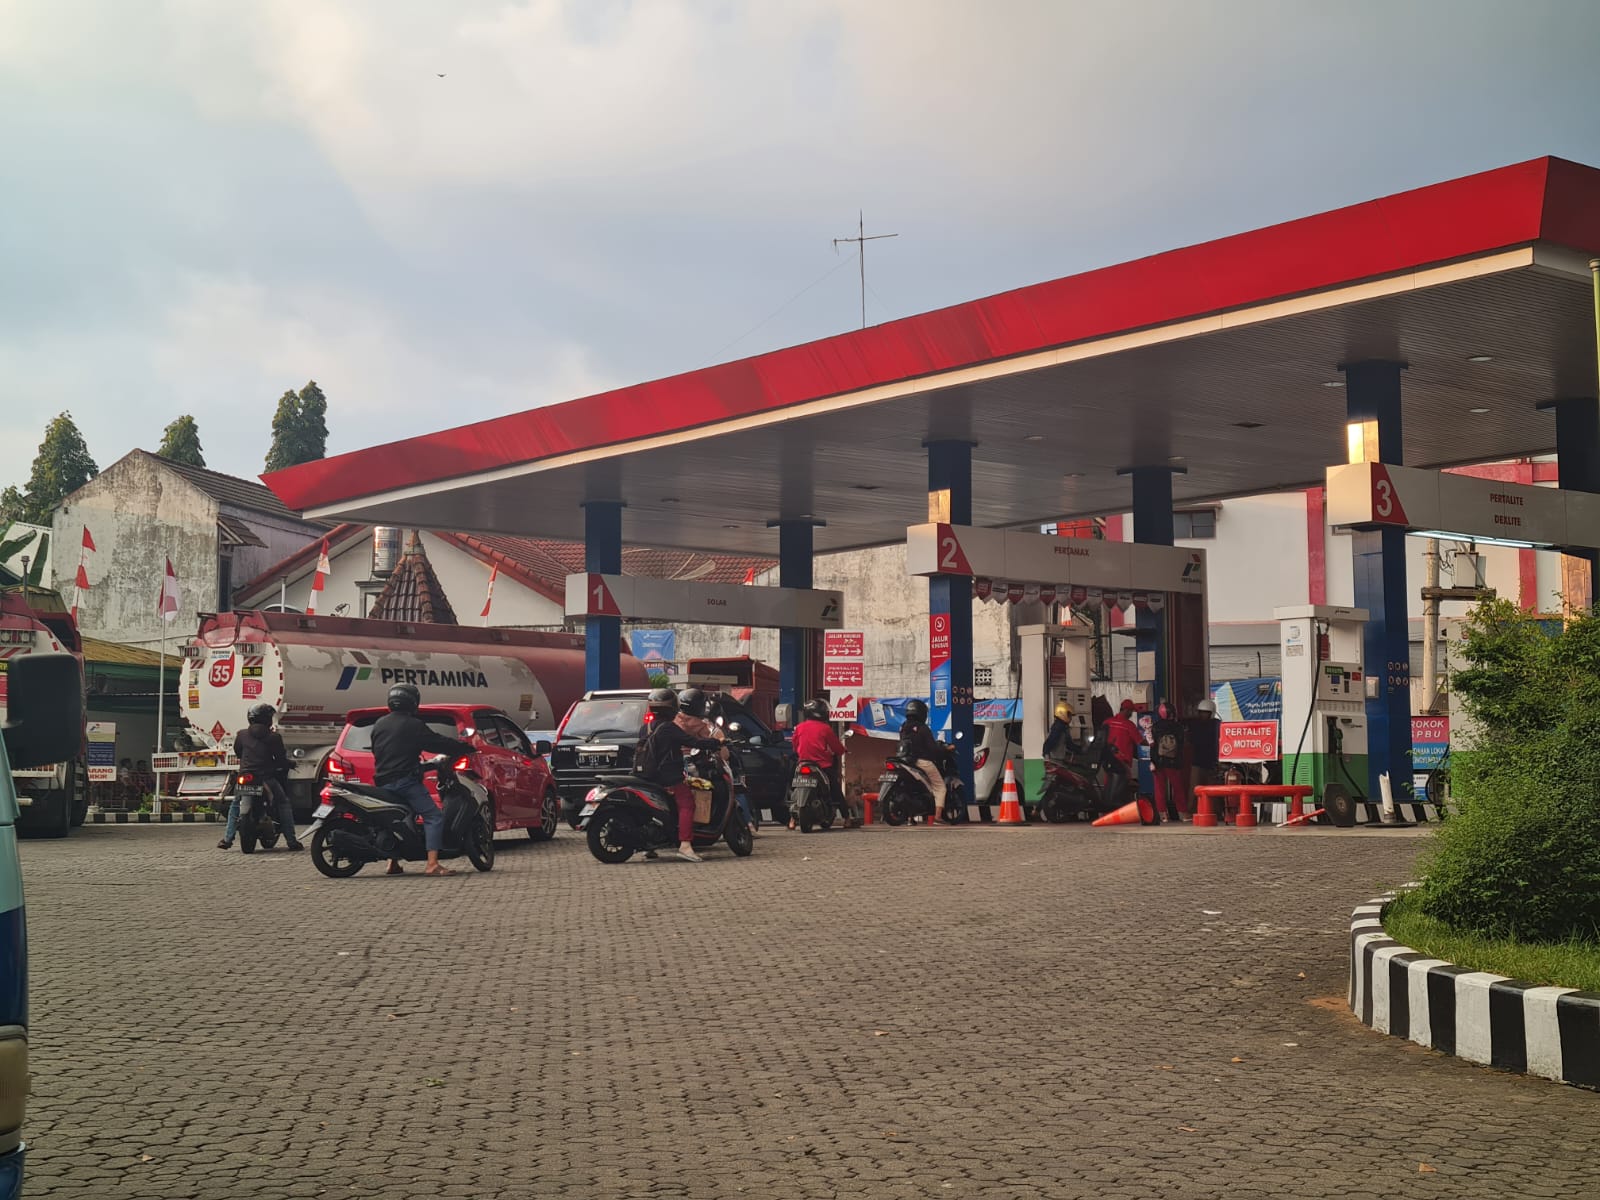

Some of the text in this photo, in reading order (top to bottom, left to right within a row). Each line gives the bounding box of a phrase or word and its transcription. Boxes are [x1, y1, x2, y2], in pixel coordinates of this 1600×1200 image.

[1376, 479, 1393, 517] 3
[1489, 493, 1524, 506] PERTALITE
[1494, 514, 1522, 527] DEXLITE
[941, 537, 957, 568] 2
[1054, 546, 1090, 557] PERTAMAX
[592, 584, 604, 611] 1
[706, 598, 727, 606] SOLAR
[931, 635, 948, 643] JALUR
[209, 665, 231, 683] 135
[380, 667, 489, 688] PERTAMINA
[829, 710, 857, 719] MOBIL
[1225, 727, 1271, 737] PERTALITE
[1233, 739, 1262, 748] MOTOR
